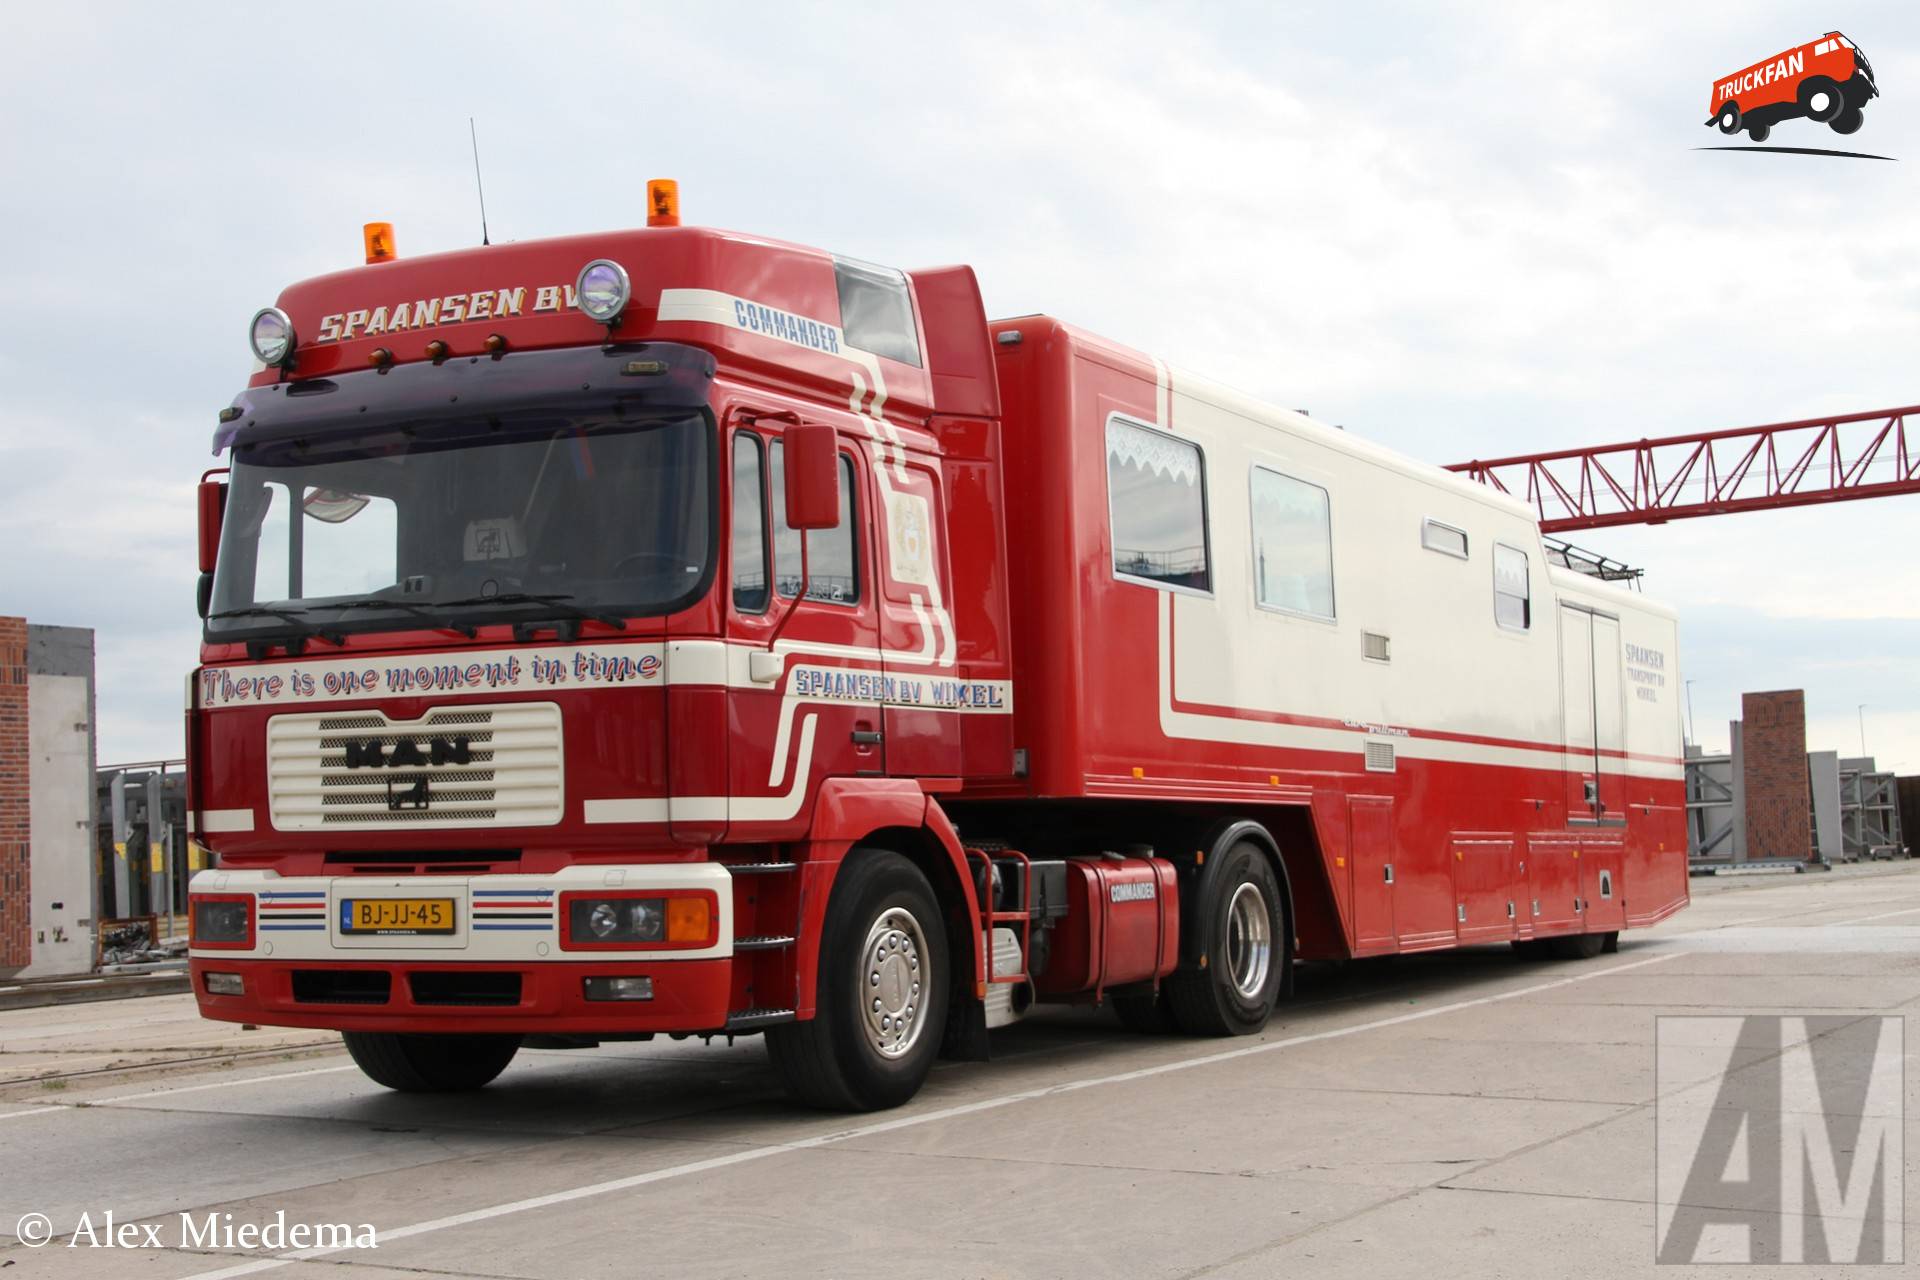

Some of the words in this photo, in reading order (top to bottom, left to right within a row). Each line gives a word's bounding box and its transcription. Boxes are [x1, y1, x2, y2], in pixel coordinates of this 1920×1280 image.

[317, 287, 526, 342] SPAANSEN
[734, 300, 839, 354] COMMANDER
[202, 669, 283, 705] There
[291, 668, 315, 697] is
[323, 669, 379, 696] one
[385, 655, 522, 693] moment
[532, 655, 567, 684] in
[573, 651, 662, 682] time
[796, 669, 897, 702] SPAANSEN
[899, 680, 922, 703] BV
[345, 736, 471, 768] MAN
[1111, 883, 1155, 902] COMMANDER
[361, 903, 442, 925] BJ-JJ-45
